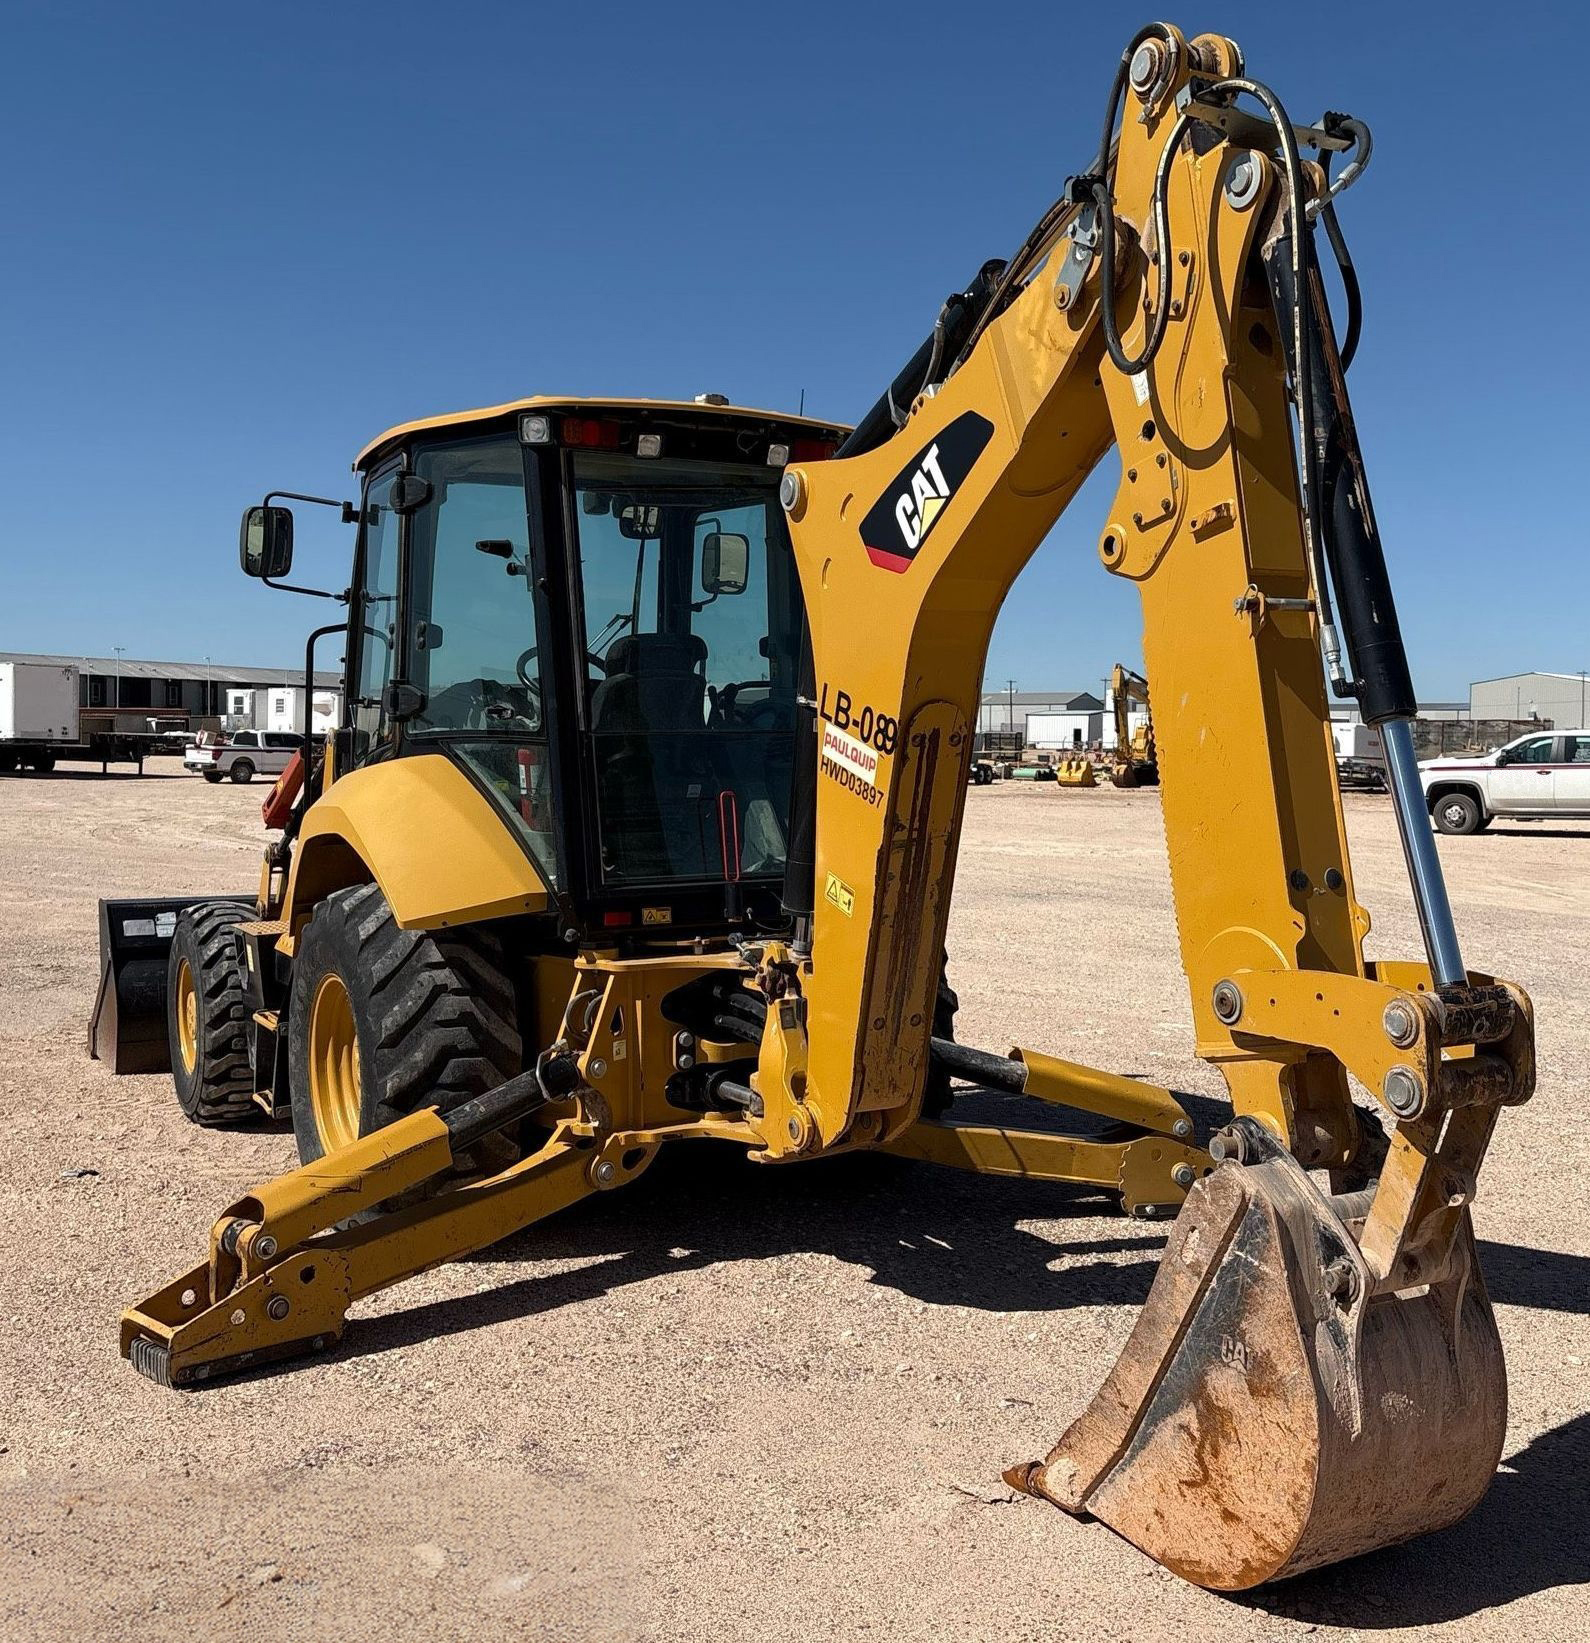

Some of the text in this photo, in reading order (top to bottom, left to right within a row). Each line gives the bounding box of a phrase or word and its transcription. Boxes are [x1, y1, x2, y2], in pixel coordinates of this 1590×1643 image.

[895, 443, 950, 549] CAT
[824, 732, 877, 772] PAULQUIP
[820, 755, 885, 808] HWD03897
